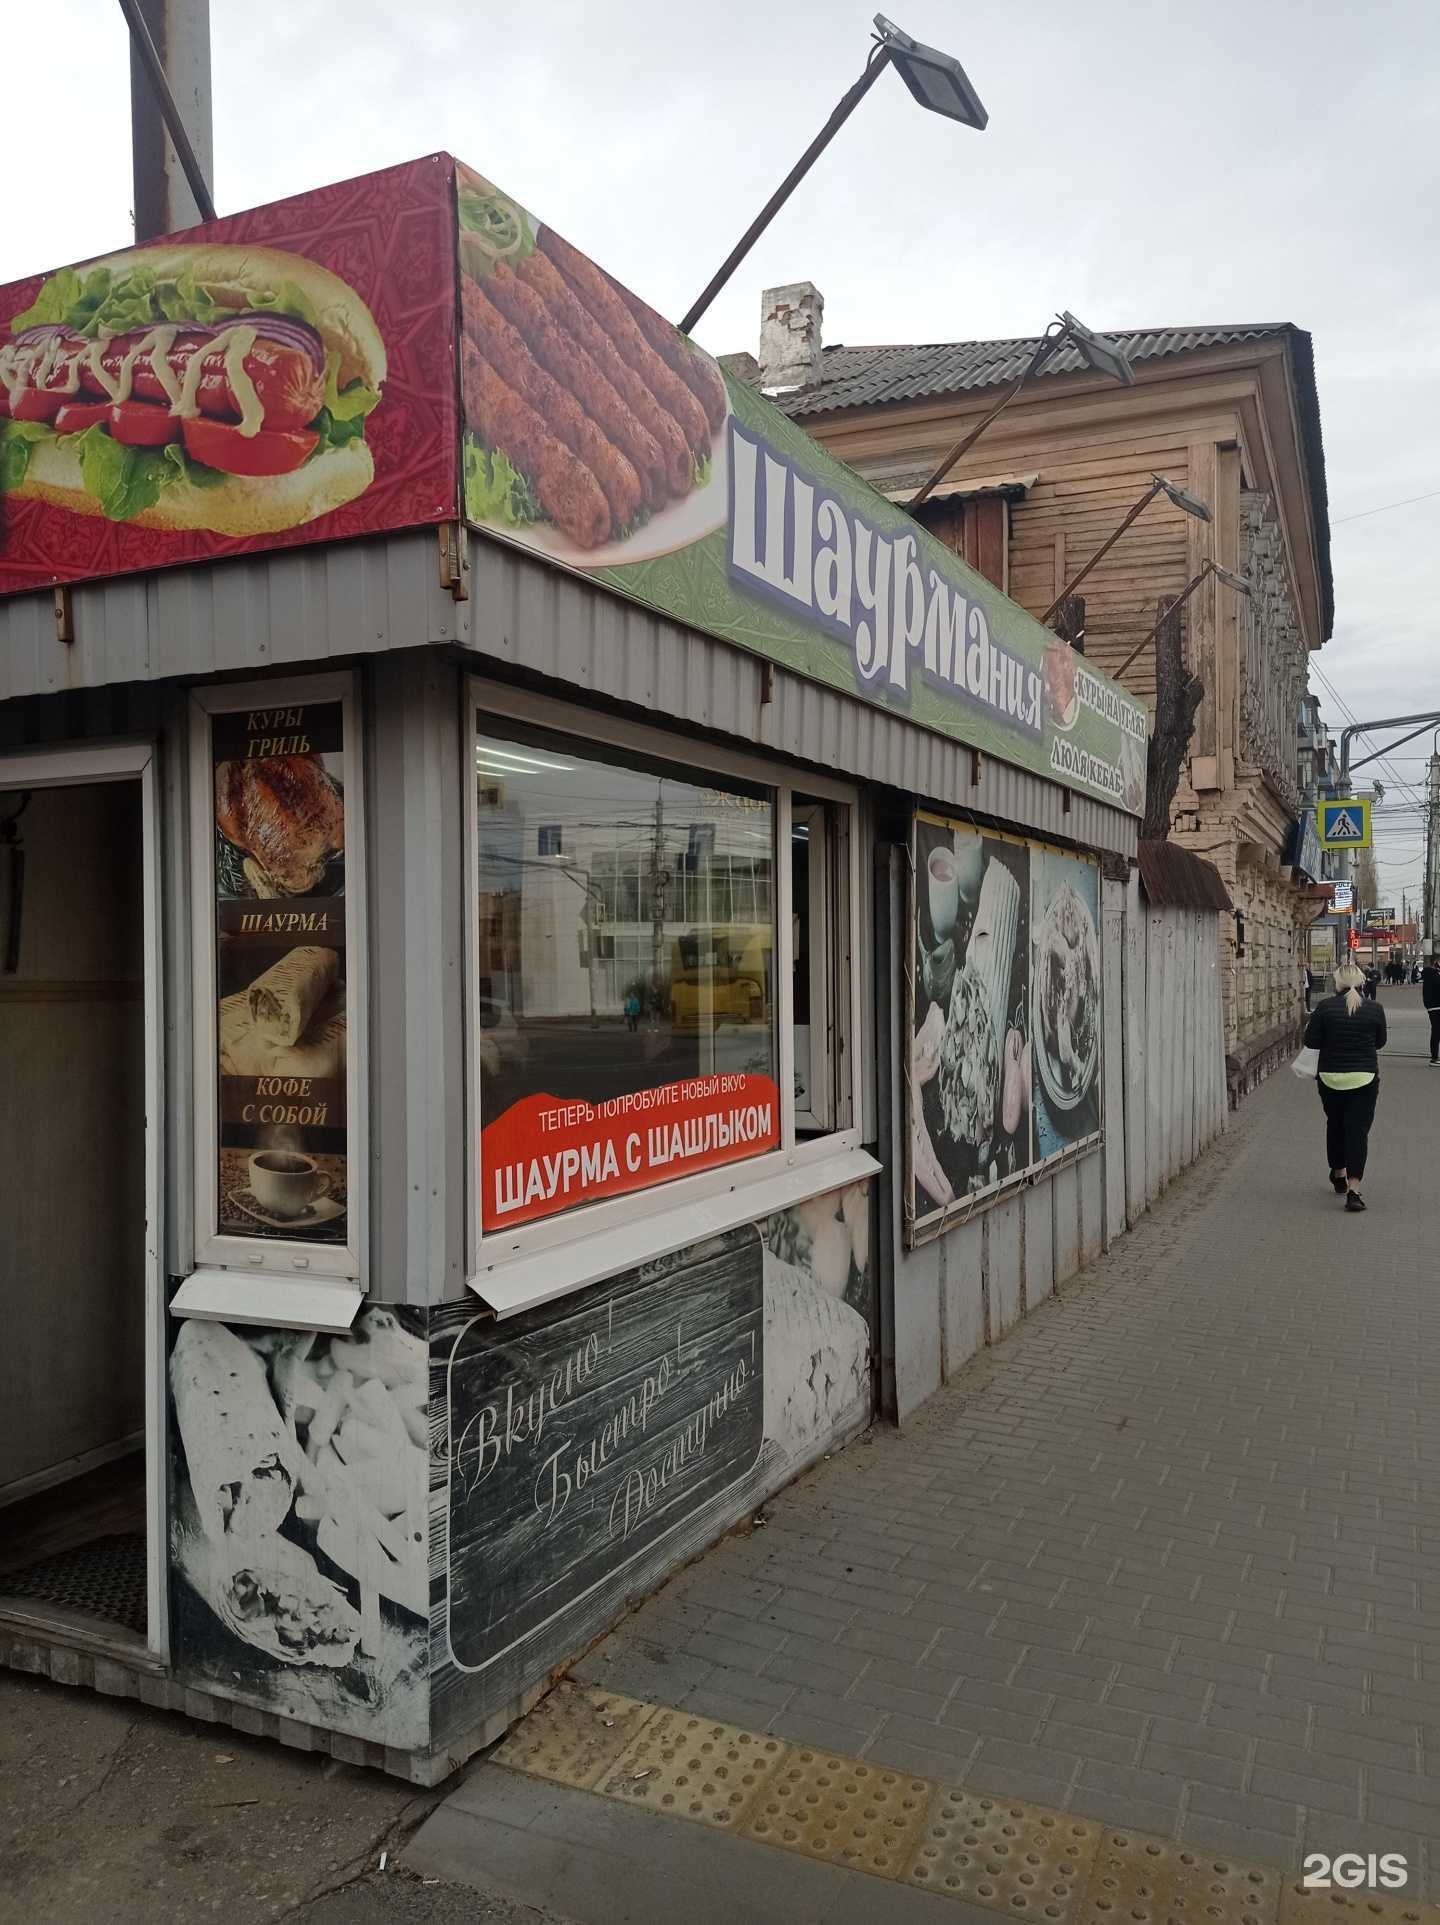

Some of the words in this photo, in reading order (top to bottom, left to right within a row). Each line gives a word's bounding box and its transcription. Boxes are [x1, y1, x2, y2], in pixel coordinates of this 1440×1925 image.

[247, 708, 304, 731] КУРЫ
[247, 734, 311, 759] ГРИЛЬ
[1052, 741, 1087, 778] ЛЮЛЯ
[240, 912, 328, 933] ШАУРМА
[255, 1077, 312, 1097] КОФЕ
[241, 1104, 256, 1122] С
[260, 1102, 328, 1125] СОБОЙ
[538, 1103, 595, 1133] ТЕПЕРЬ
[598, 1085, 679, 1120] ПОПРОБУЙТЕ
[681, 1075, 719, 1101] НОВЫЙ
[721, 1074, 746, 1094] ВКУС
[495, 1139, 620, 1215] ШАУРМА
[625, 1132, 641, 1172] С
[648, 1103, 772, 1167] ШАШЛЫКОМ
